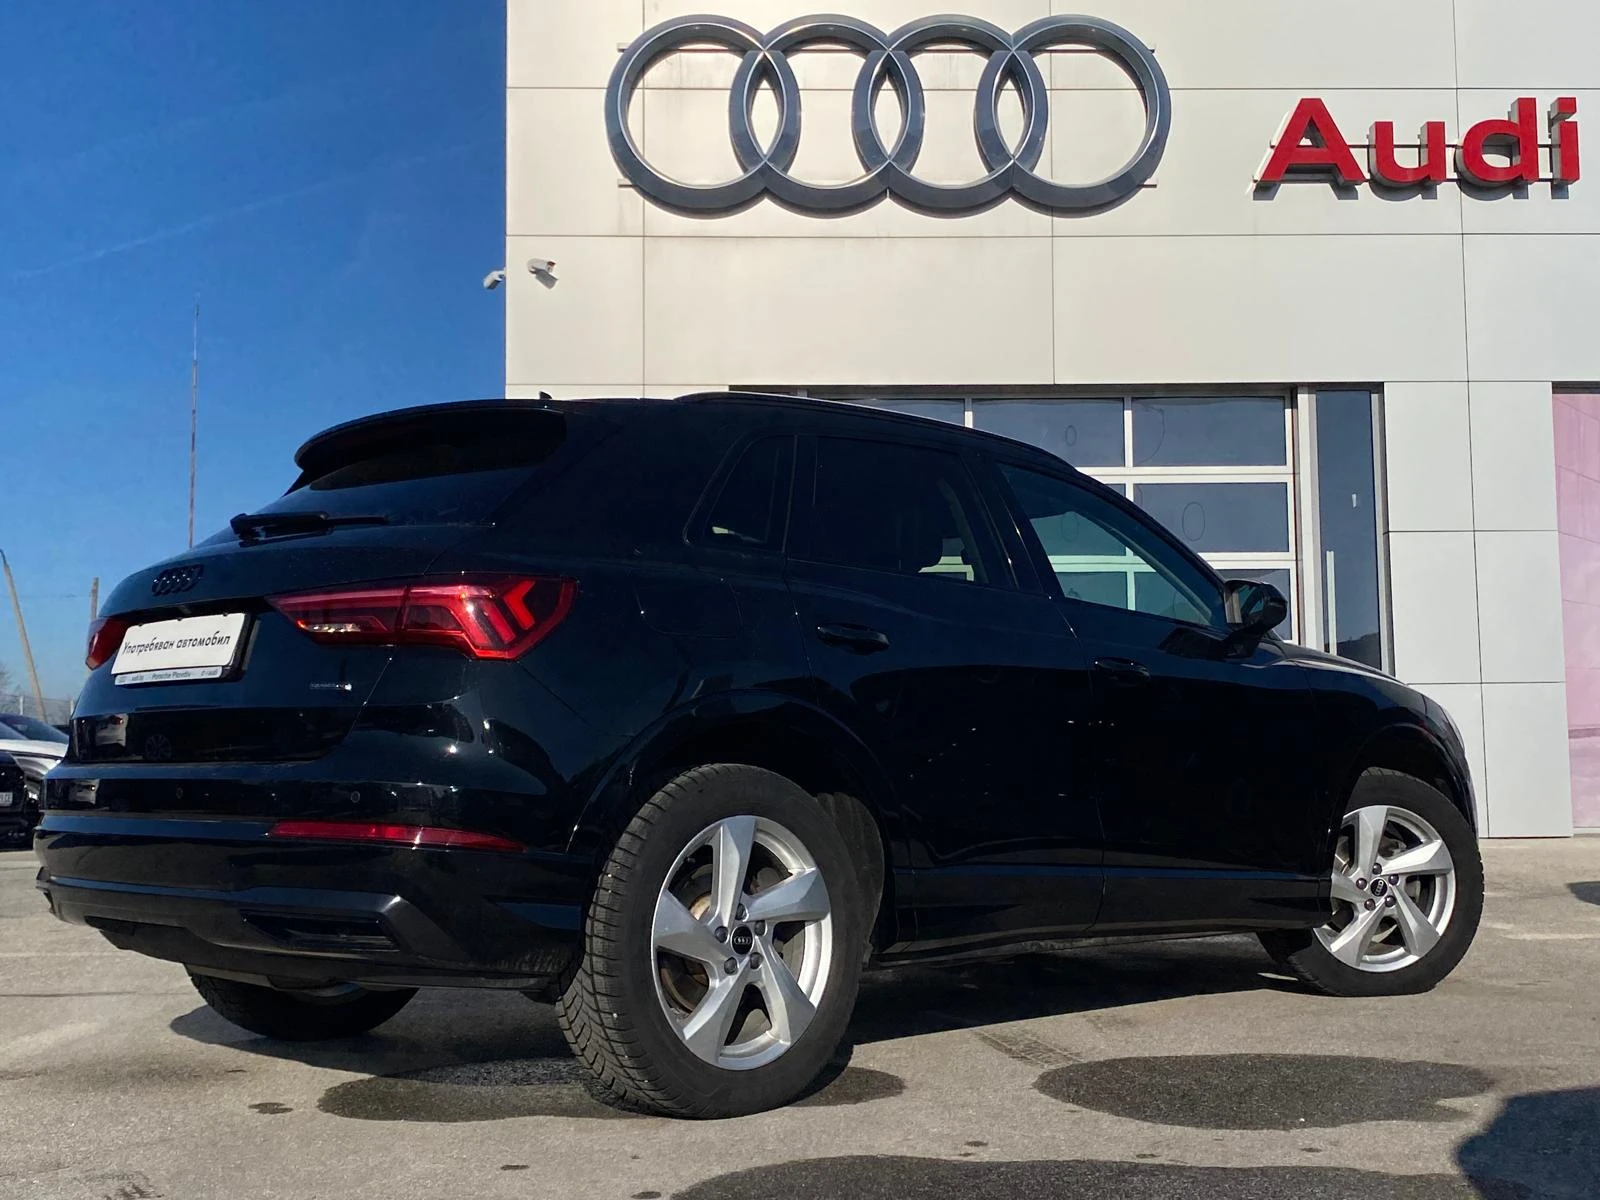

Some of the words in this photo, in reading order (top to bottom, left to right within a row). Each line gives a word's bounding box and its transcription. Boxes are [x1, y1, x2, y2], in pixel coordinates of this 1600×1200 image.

[1260, 97, 1580, 184] Audi
[122, 636, 175, 656] Употребяван
[176, 630, 231, 649] автомобил
